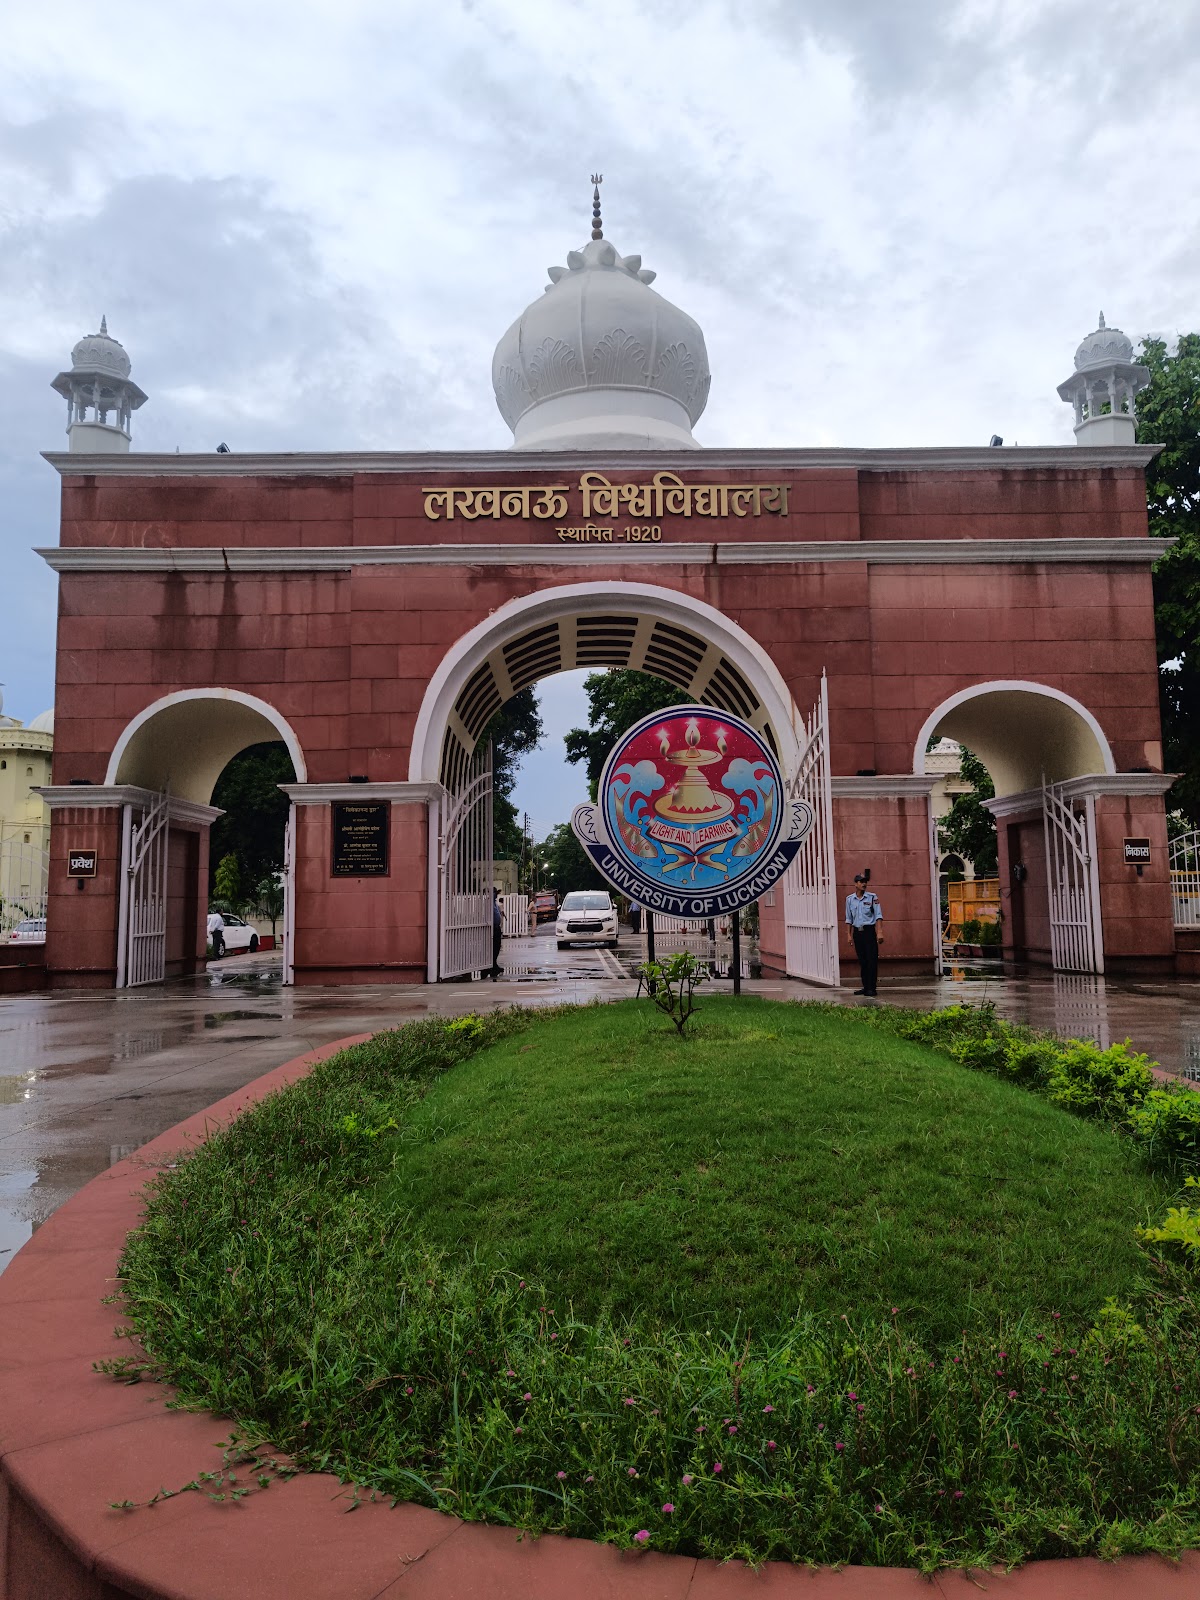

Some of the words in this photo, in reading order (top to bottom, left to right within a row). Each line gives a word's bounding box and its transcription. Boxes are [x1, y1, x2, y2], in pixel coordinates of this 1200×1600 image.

[421, 486, 570, 520] लखनऊ
[578, 471, 792, 518] विश्वविद्यालय
[555, 522, 614, 542] स्थापित
[651, 822, 675, 839] LIGHT
[675, 829, 692, 844] AND
[695, 822, 733, 844] LEARNING
[1125, 844, 1150, 857] निकास
[71, 856, 95, 870] प्रवेश
[601, 853, 688, 914] UNIVERSITY
[691, 898, 715, 914] OF
[716, 850, 789, 911] LUCKNOW
